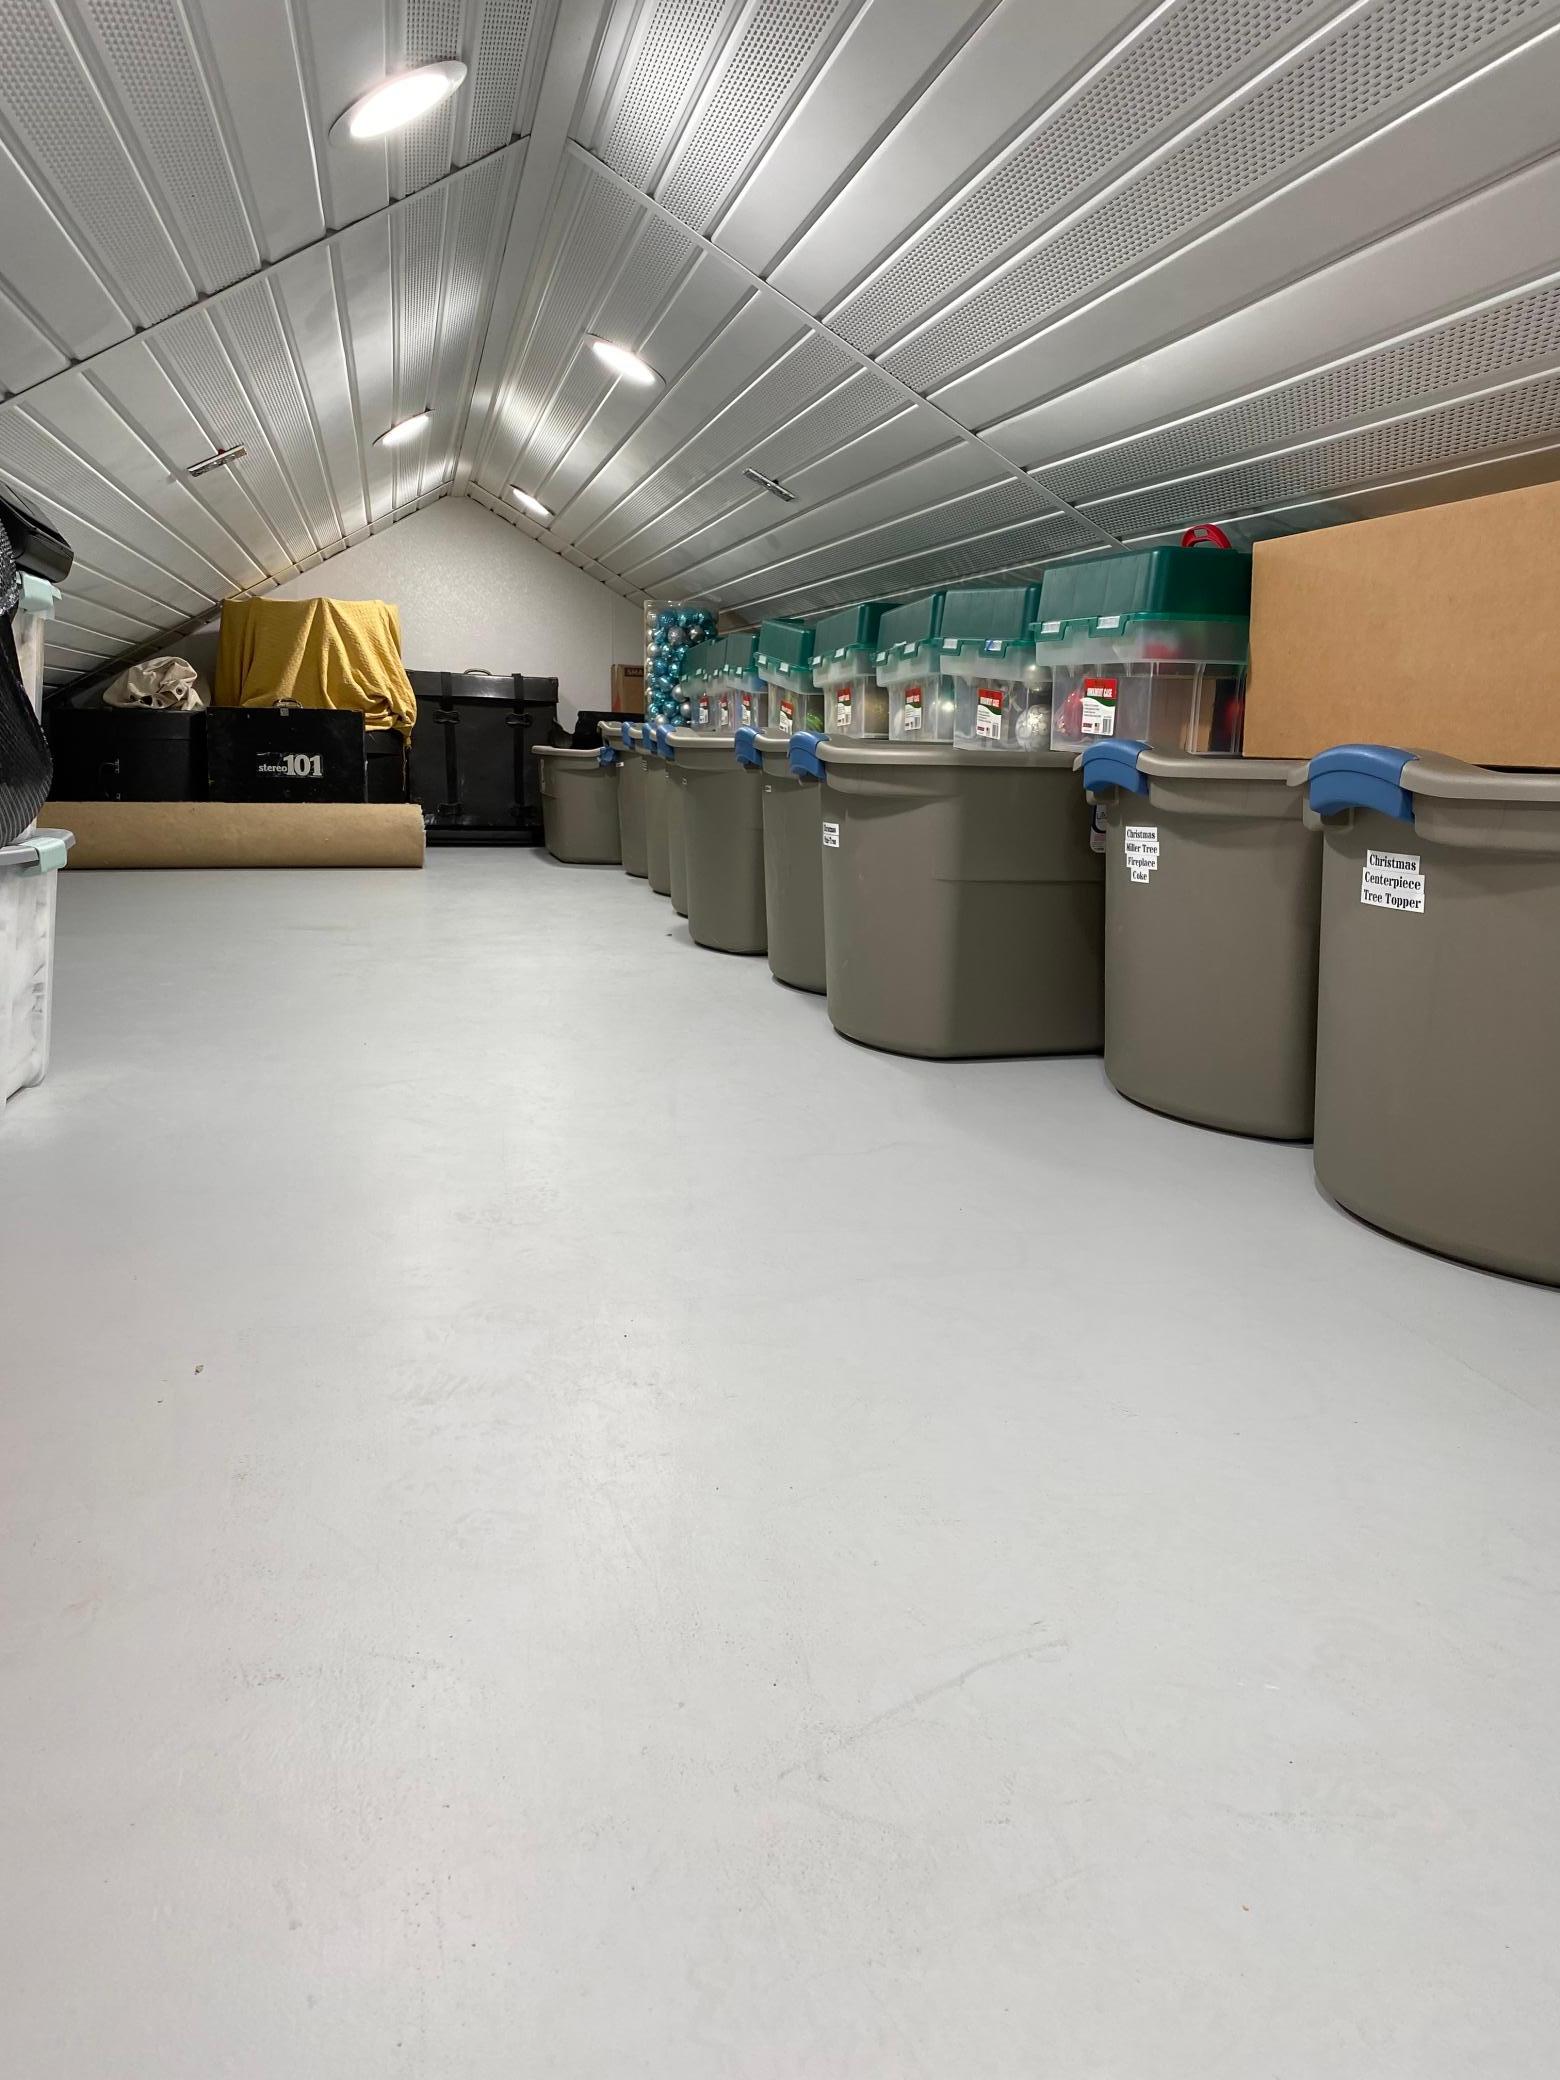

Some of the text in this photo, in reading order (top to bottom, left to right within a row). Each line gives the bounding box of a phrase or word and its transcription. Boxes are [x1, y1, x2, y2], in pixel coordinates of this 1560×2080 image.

[1126, 829, 1156, 839] Christmas
[1142, 844, 1158, 853] Tree
[1128, 856, 1156, 868] Fireplace
[1369, 853, 1417, 871] Christmas
[1364, 871, 1421, 890] Centerpiece
[1363, 889, 1422, 909] Tree Topper
